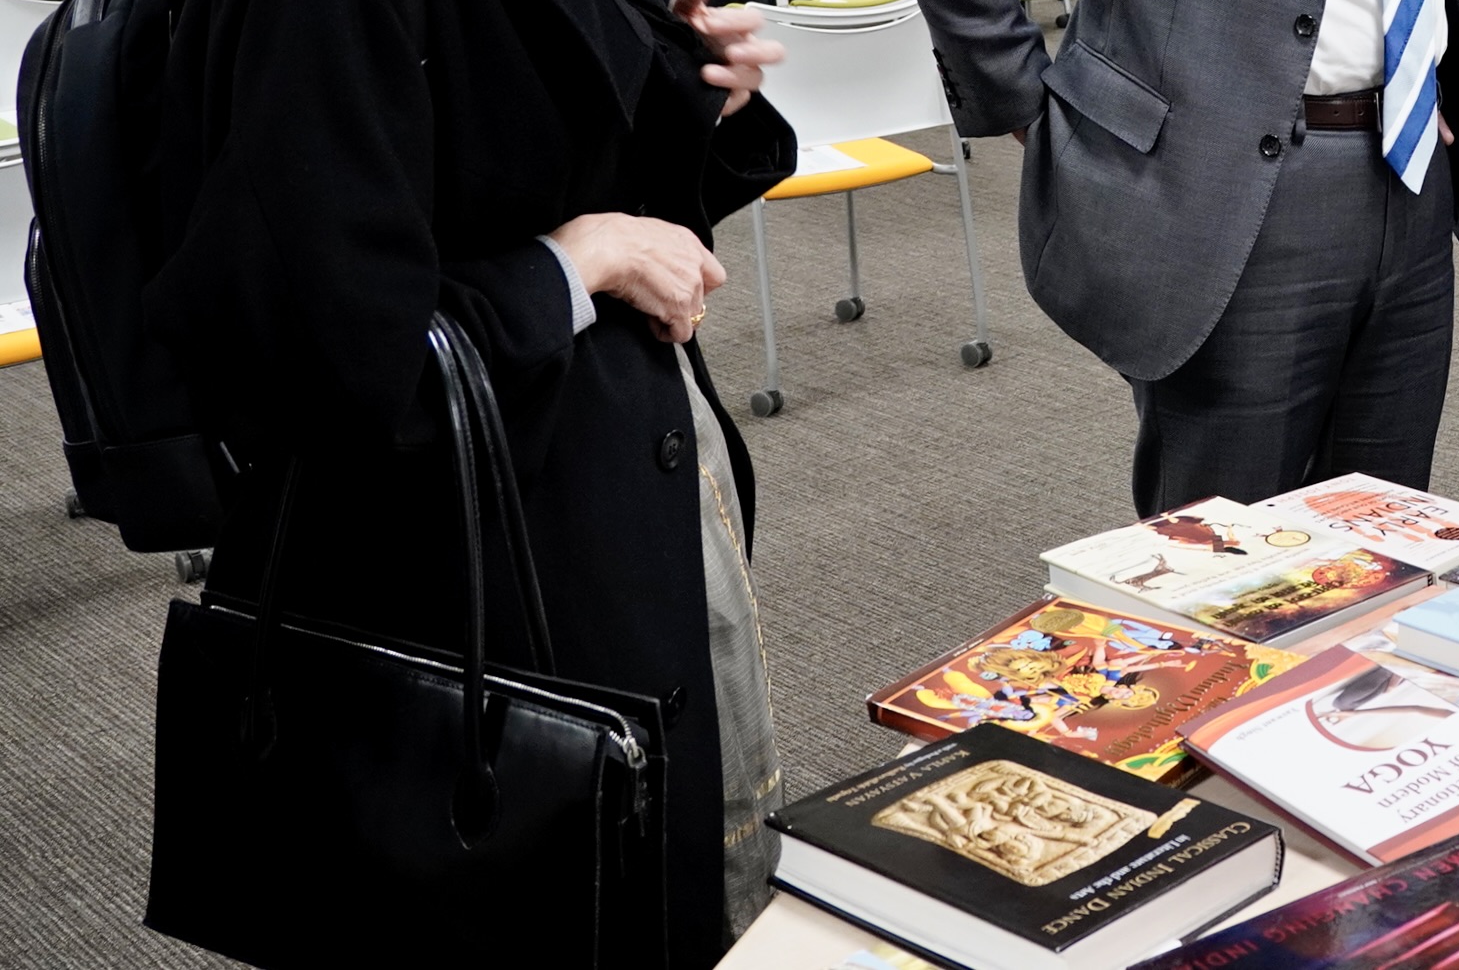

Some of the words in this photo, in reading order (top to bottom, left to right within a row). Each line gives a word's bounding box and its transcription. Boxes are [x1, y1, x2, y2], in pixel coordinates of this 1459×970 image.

[1322, 493, 1437, 532] INDIANS
[1363, 505, 1450, 536] EARLY
[918, 749, 972, 772] KAPILA
[1339, 732, 1453, 800] YOGA
[1374, 765, 1452, 811] Modern
[1123, 839, 1182, 868] Literature
[1164, 819, 1256, 866] CLASSICAL
[1101, 862, 1177, 900] INDIAN
[1034, 896, 1114, 936] DANCE
[1260, 876, 1407, 944] CHANGING
